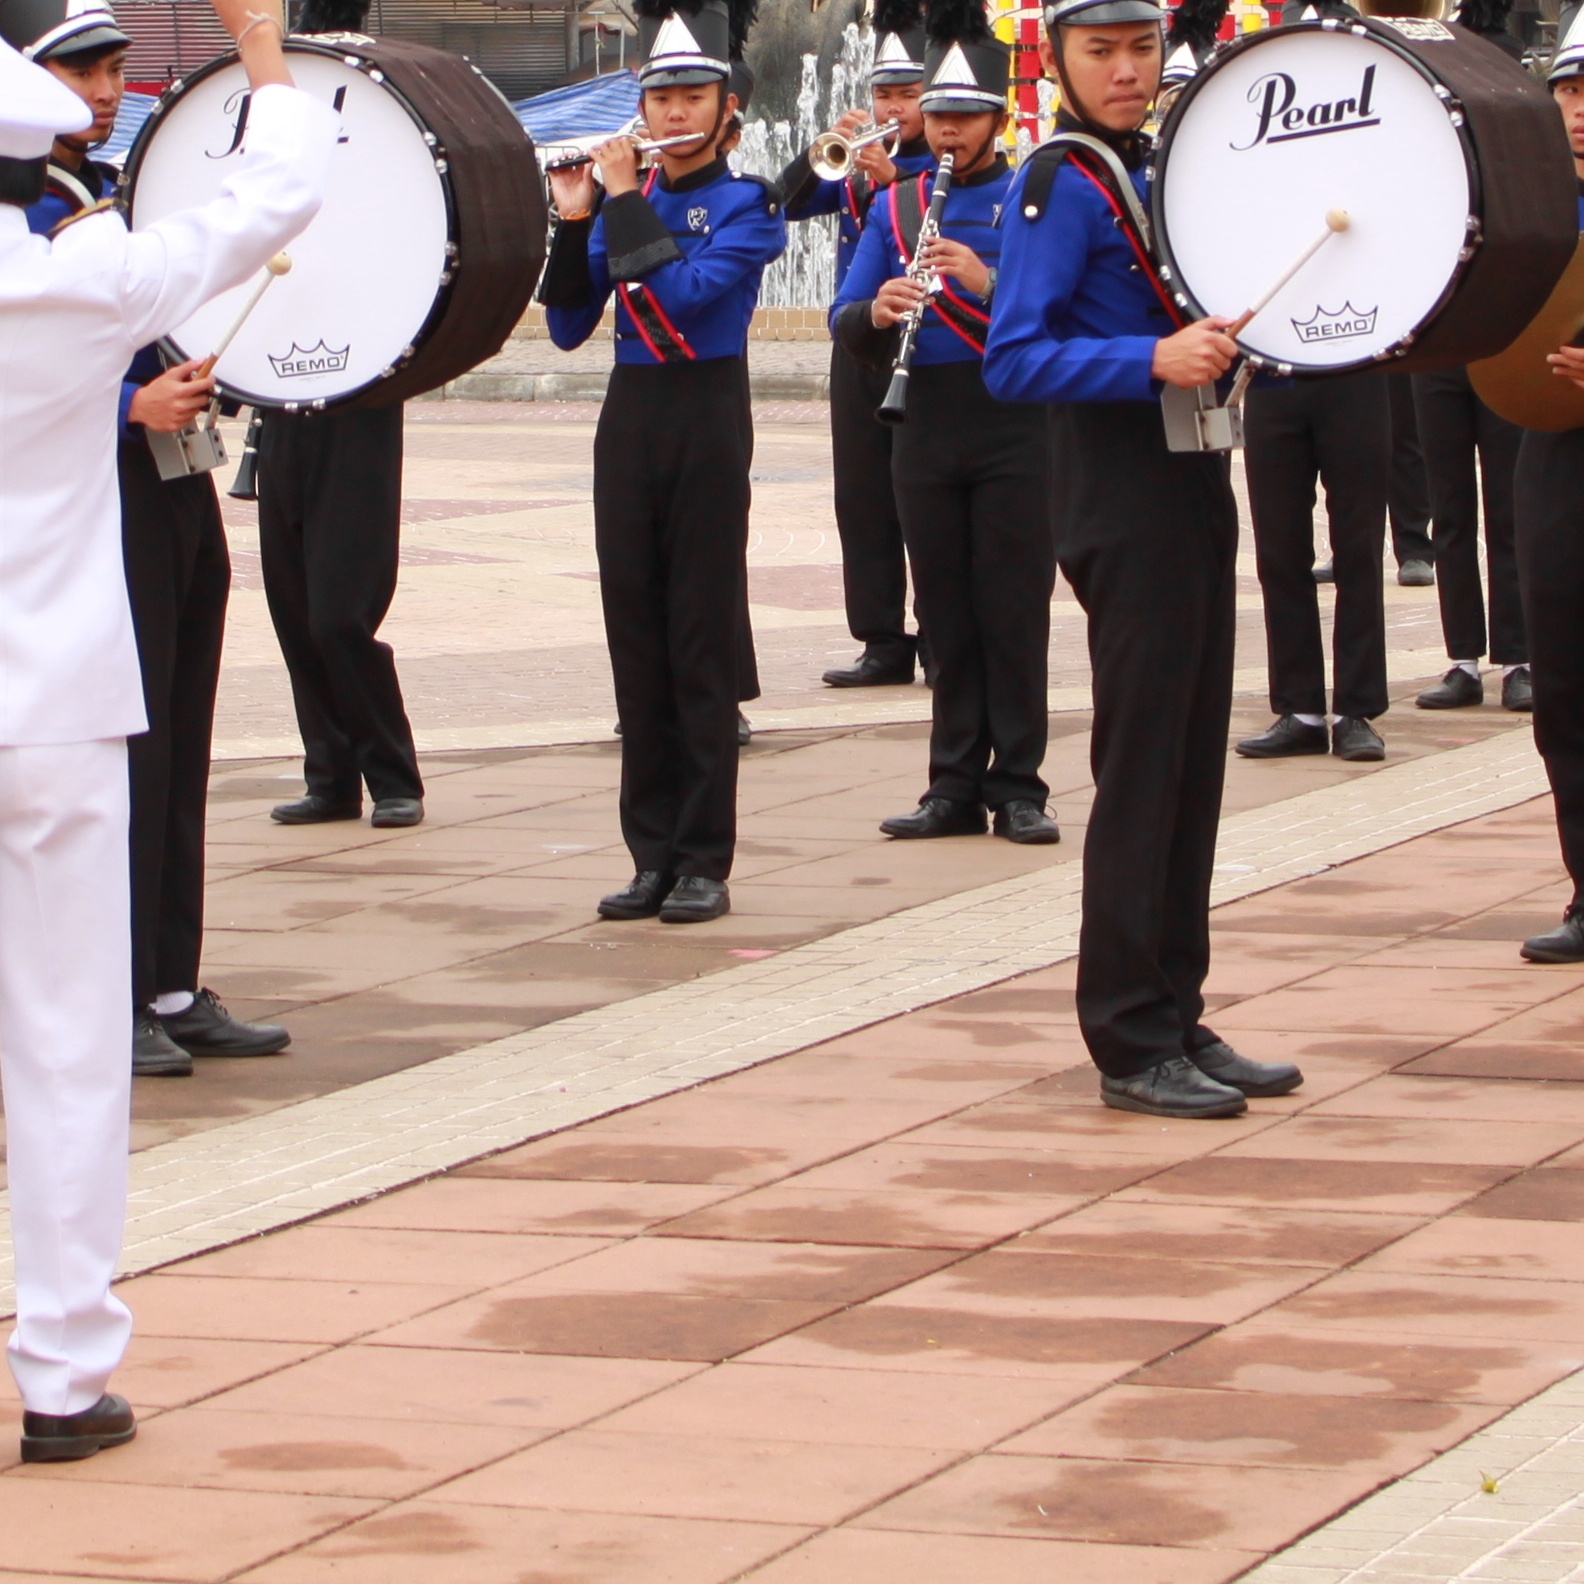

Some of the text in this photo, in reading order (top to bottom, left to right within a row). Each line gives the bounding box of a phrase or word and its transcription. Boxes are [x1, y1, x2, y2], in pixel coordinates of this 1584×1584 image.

[1229, 63, 1377, 151] Pearl
[1306, 319, 1368, 339] REMO
[282, 357, 340, 374] REMO
